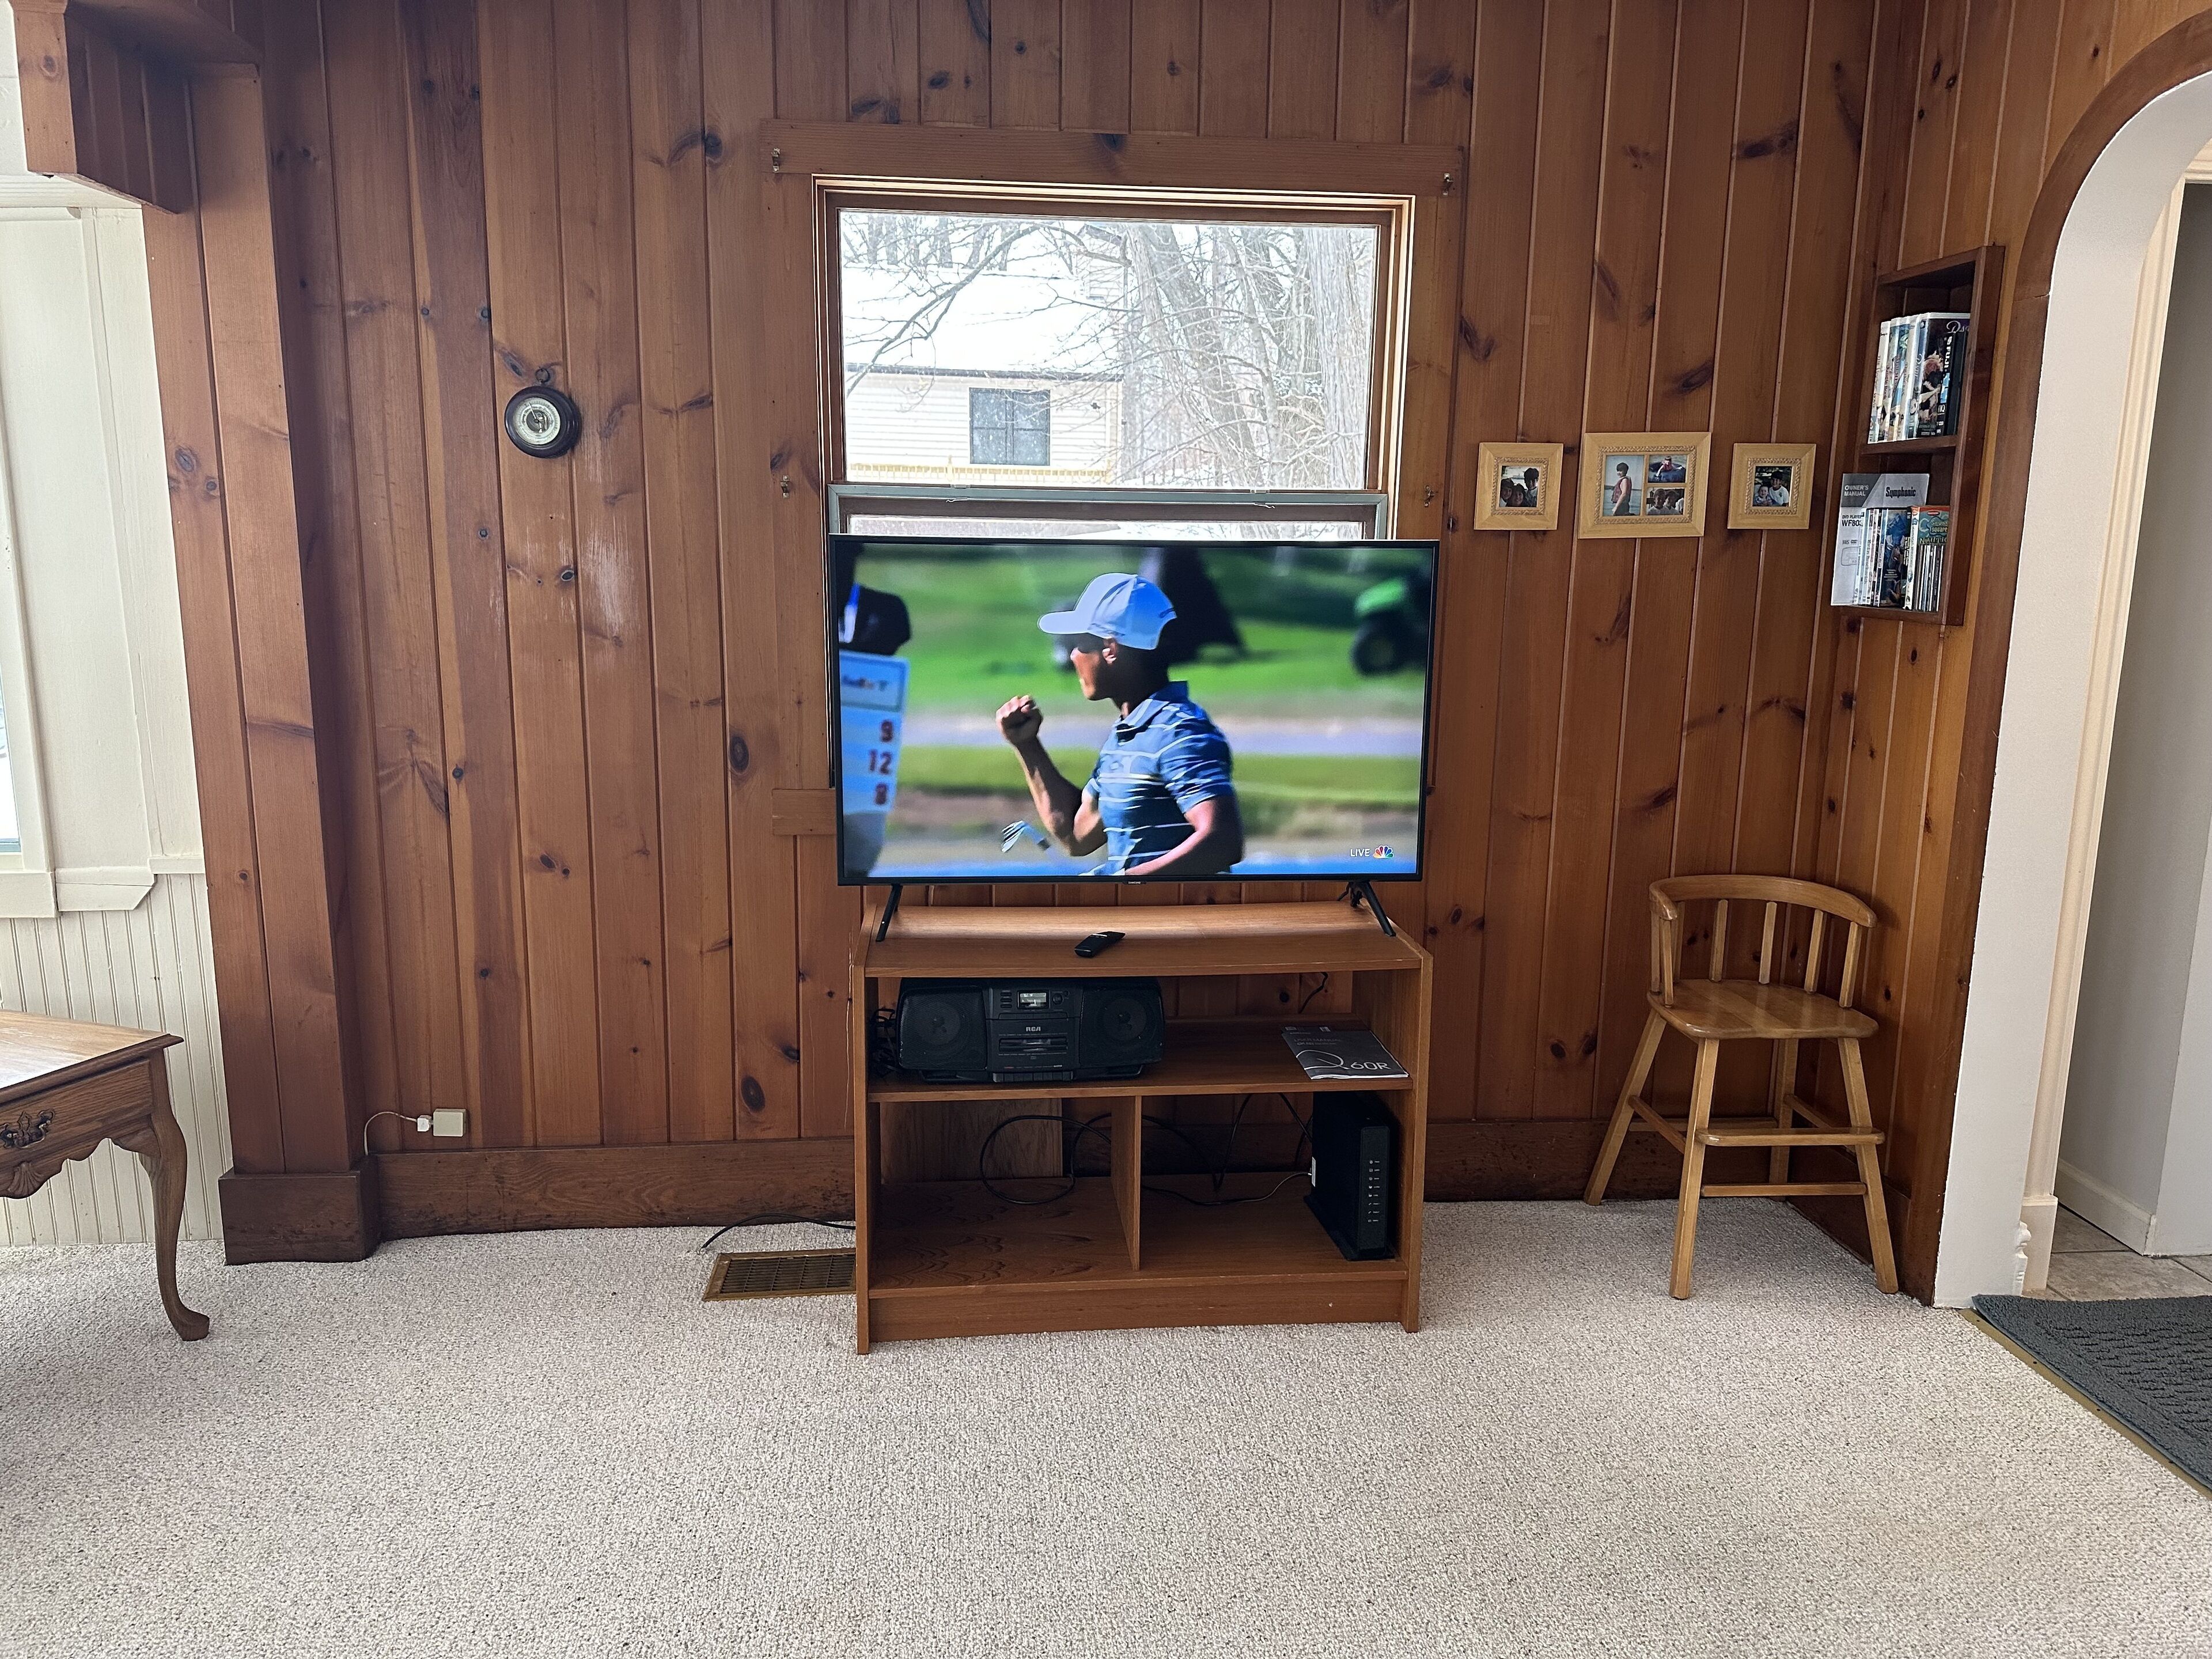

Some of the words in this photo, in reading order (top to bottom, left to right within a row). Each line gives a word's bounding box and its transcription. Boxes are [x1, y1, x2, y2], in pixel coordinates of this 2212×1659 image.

[1885, 486, 1916, 498] Symphonic
[868, 749, 893, 775] 12
[1350, 848, 1370, 857] LIVE
